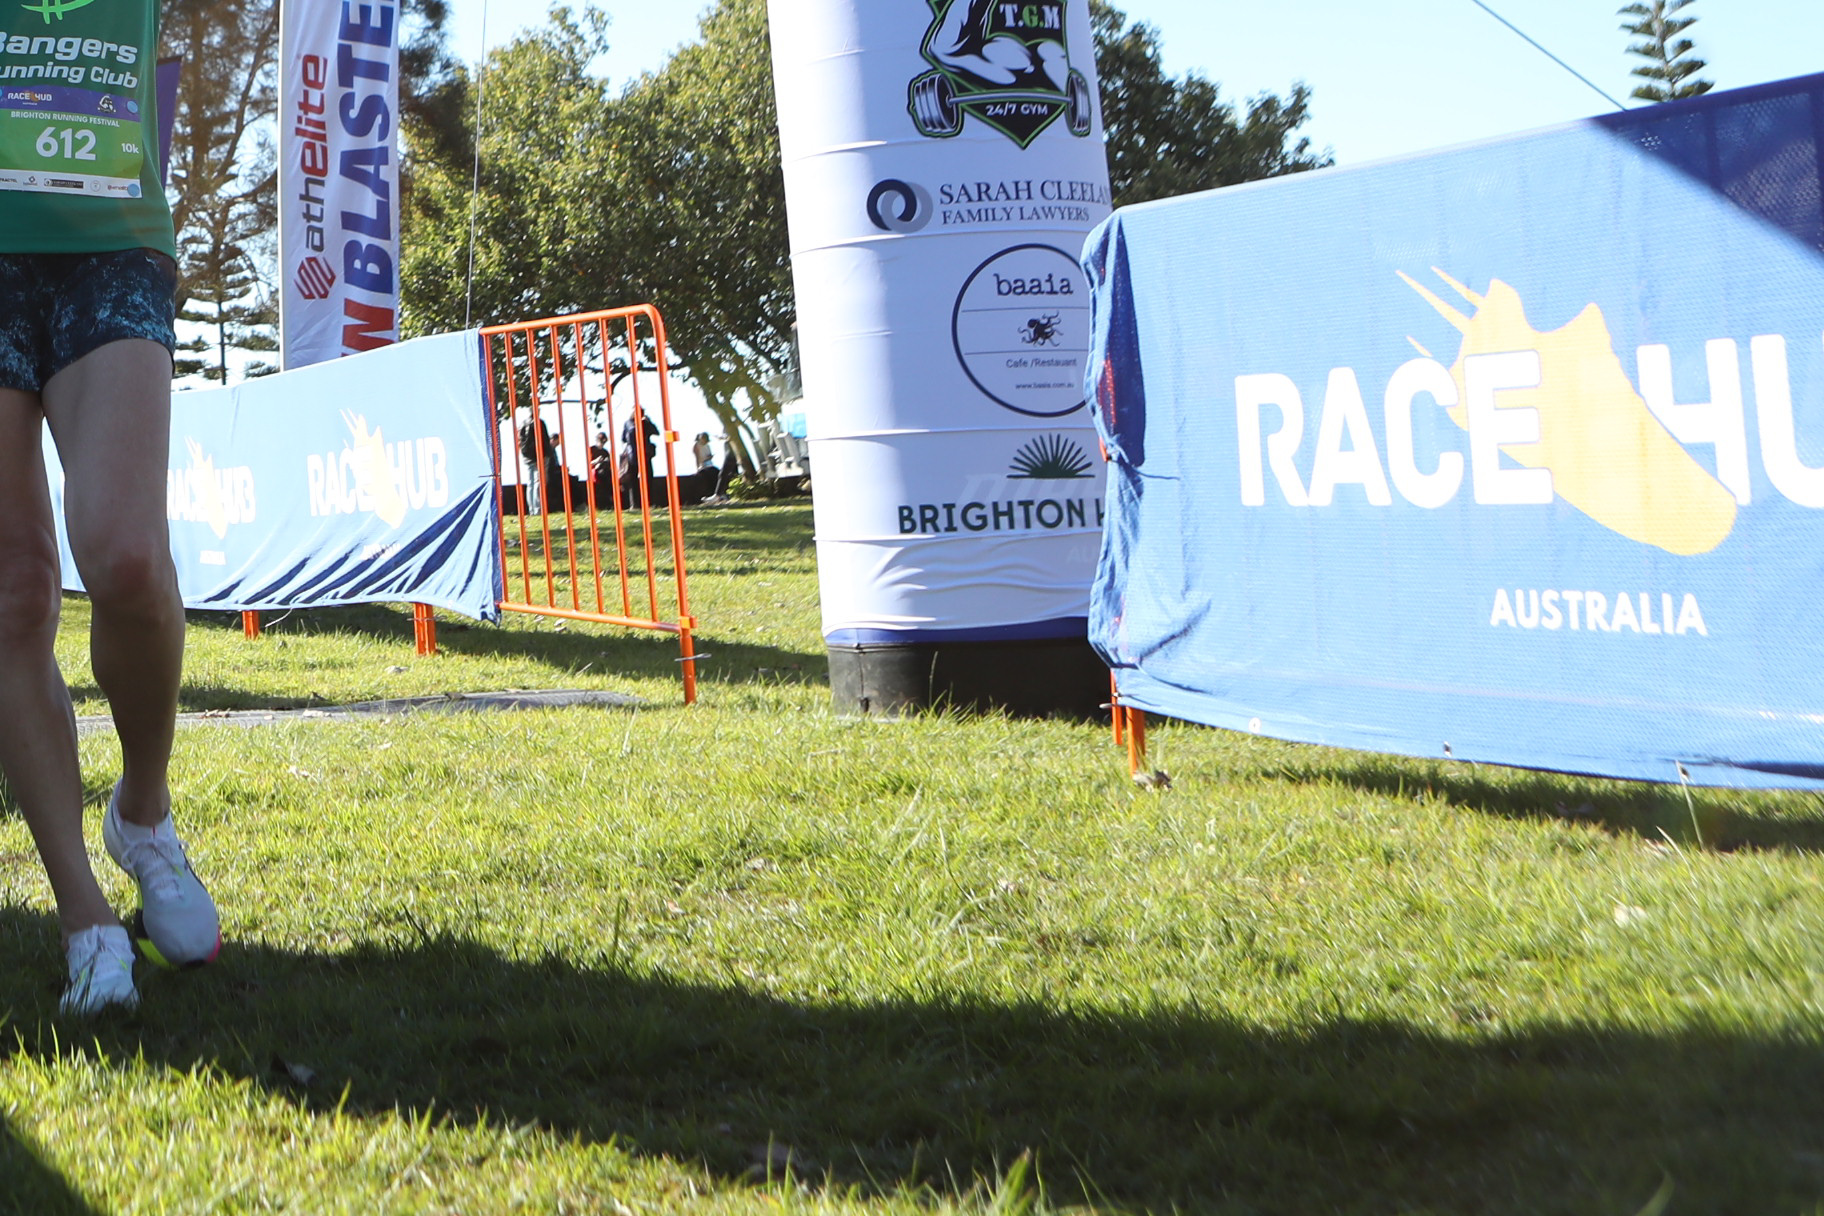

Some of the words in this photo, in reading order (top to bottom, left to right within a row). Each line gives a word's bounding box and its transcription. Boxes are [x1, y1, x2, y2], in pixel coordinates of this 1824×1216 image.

[999, 3, 1060, 30] T.G.M
[90, 66, 139, 88] Club
[7, 92, 31, 101] RACE
[985, 102, 1016, 116] 24/7
[1020, 103, 1049, 116] GYM
[10, 110, 51, 121] BRIGHTON
[52, 113, 88, 124] RUNNING
[89, 116, 120, 128] FESTIVAL
[35, 126, 97, 161] 612
[121, 142, 140, 155] 10k
[294, 54, 328, 253] athelite
[939, 180, 1035, 205] SARAH
[942, 206, 1014, 225] FAMILY
[1019, 205, 1090, 222] LAWYERS
[1006, 358, 1029, 369] Cafe
[1234, 349, 1554, 509] RACE
[307, 442, 375, 517] RACE
[385, 436, 449, 511] HUB
[898, 497, 1086, 534] BRIGHTON
[1490, 588, 1709, 636] AUSTRALIA
